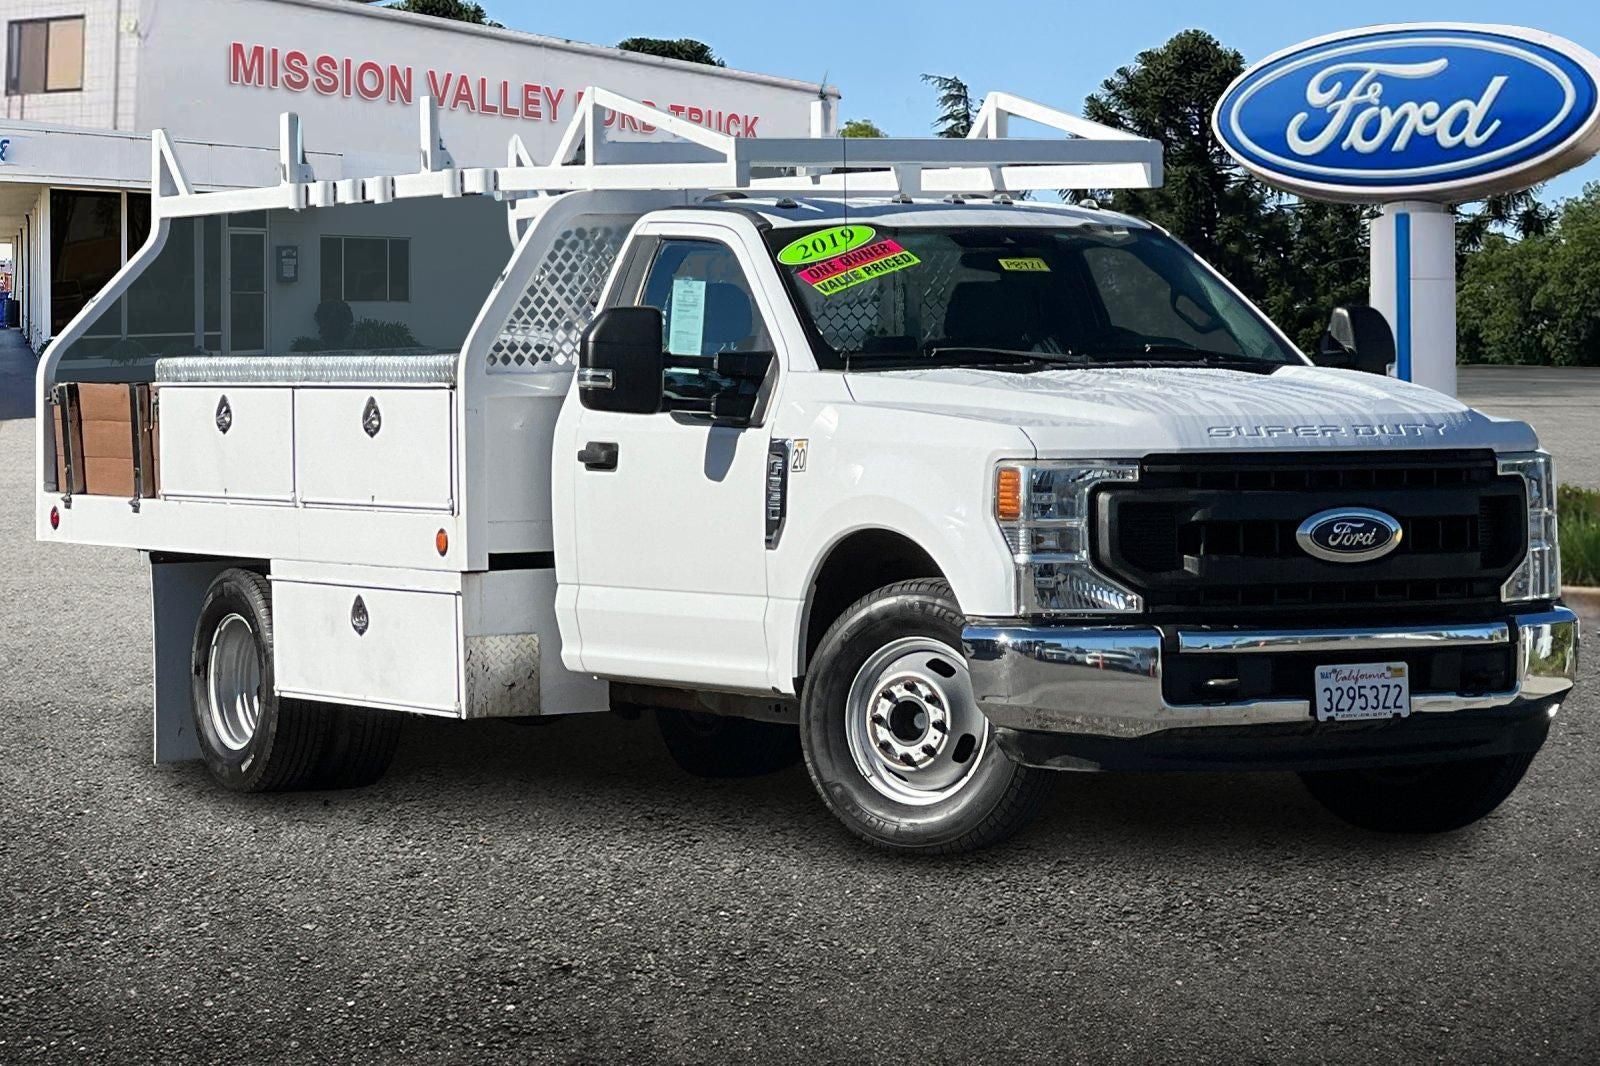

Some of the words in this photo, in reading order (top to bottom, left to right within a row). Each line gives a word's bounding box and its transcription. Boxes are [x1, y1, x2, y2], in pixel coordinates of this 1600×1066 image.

[230, 41, 413, 104] MISSION
[427, 69, 566, 123] VALLEY
[1286, 58, 1508, 156] Ford
[796, 228, 855, 260] 2019
[808, 260, 839, 279] ONE
[840, 243, 891, 267] OWNER
[816, 270, 861, 292] VALUE
[861, 253, 915, 276] PRICED
[1207, 425, 1348, 438] SUPER
[1351, 423, 1447, 438] DUTY
[792, 449, 806, 470] 20
[1328, 522, 1377, 546] Ford
[1335, 669, 1390, 684] California
[1323, 684, 1403, 712] 32953Z2
